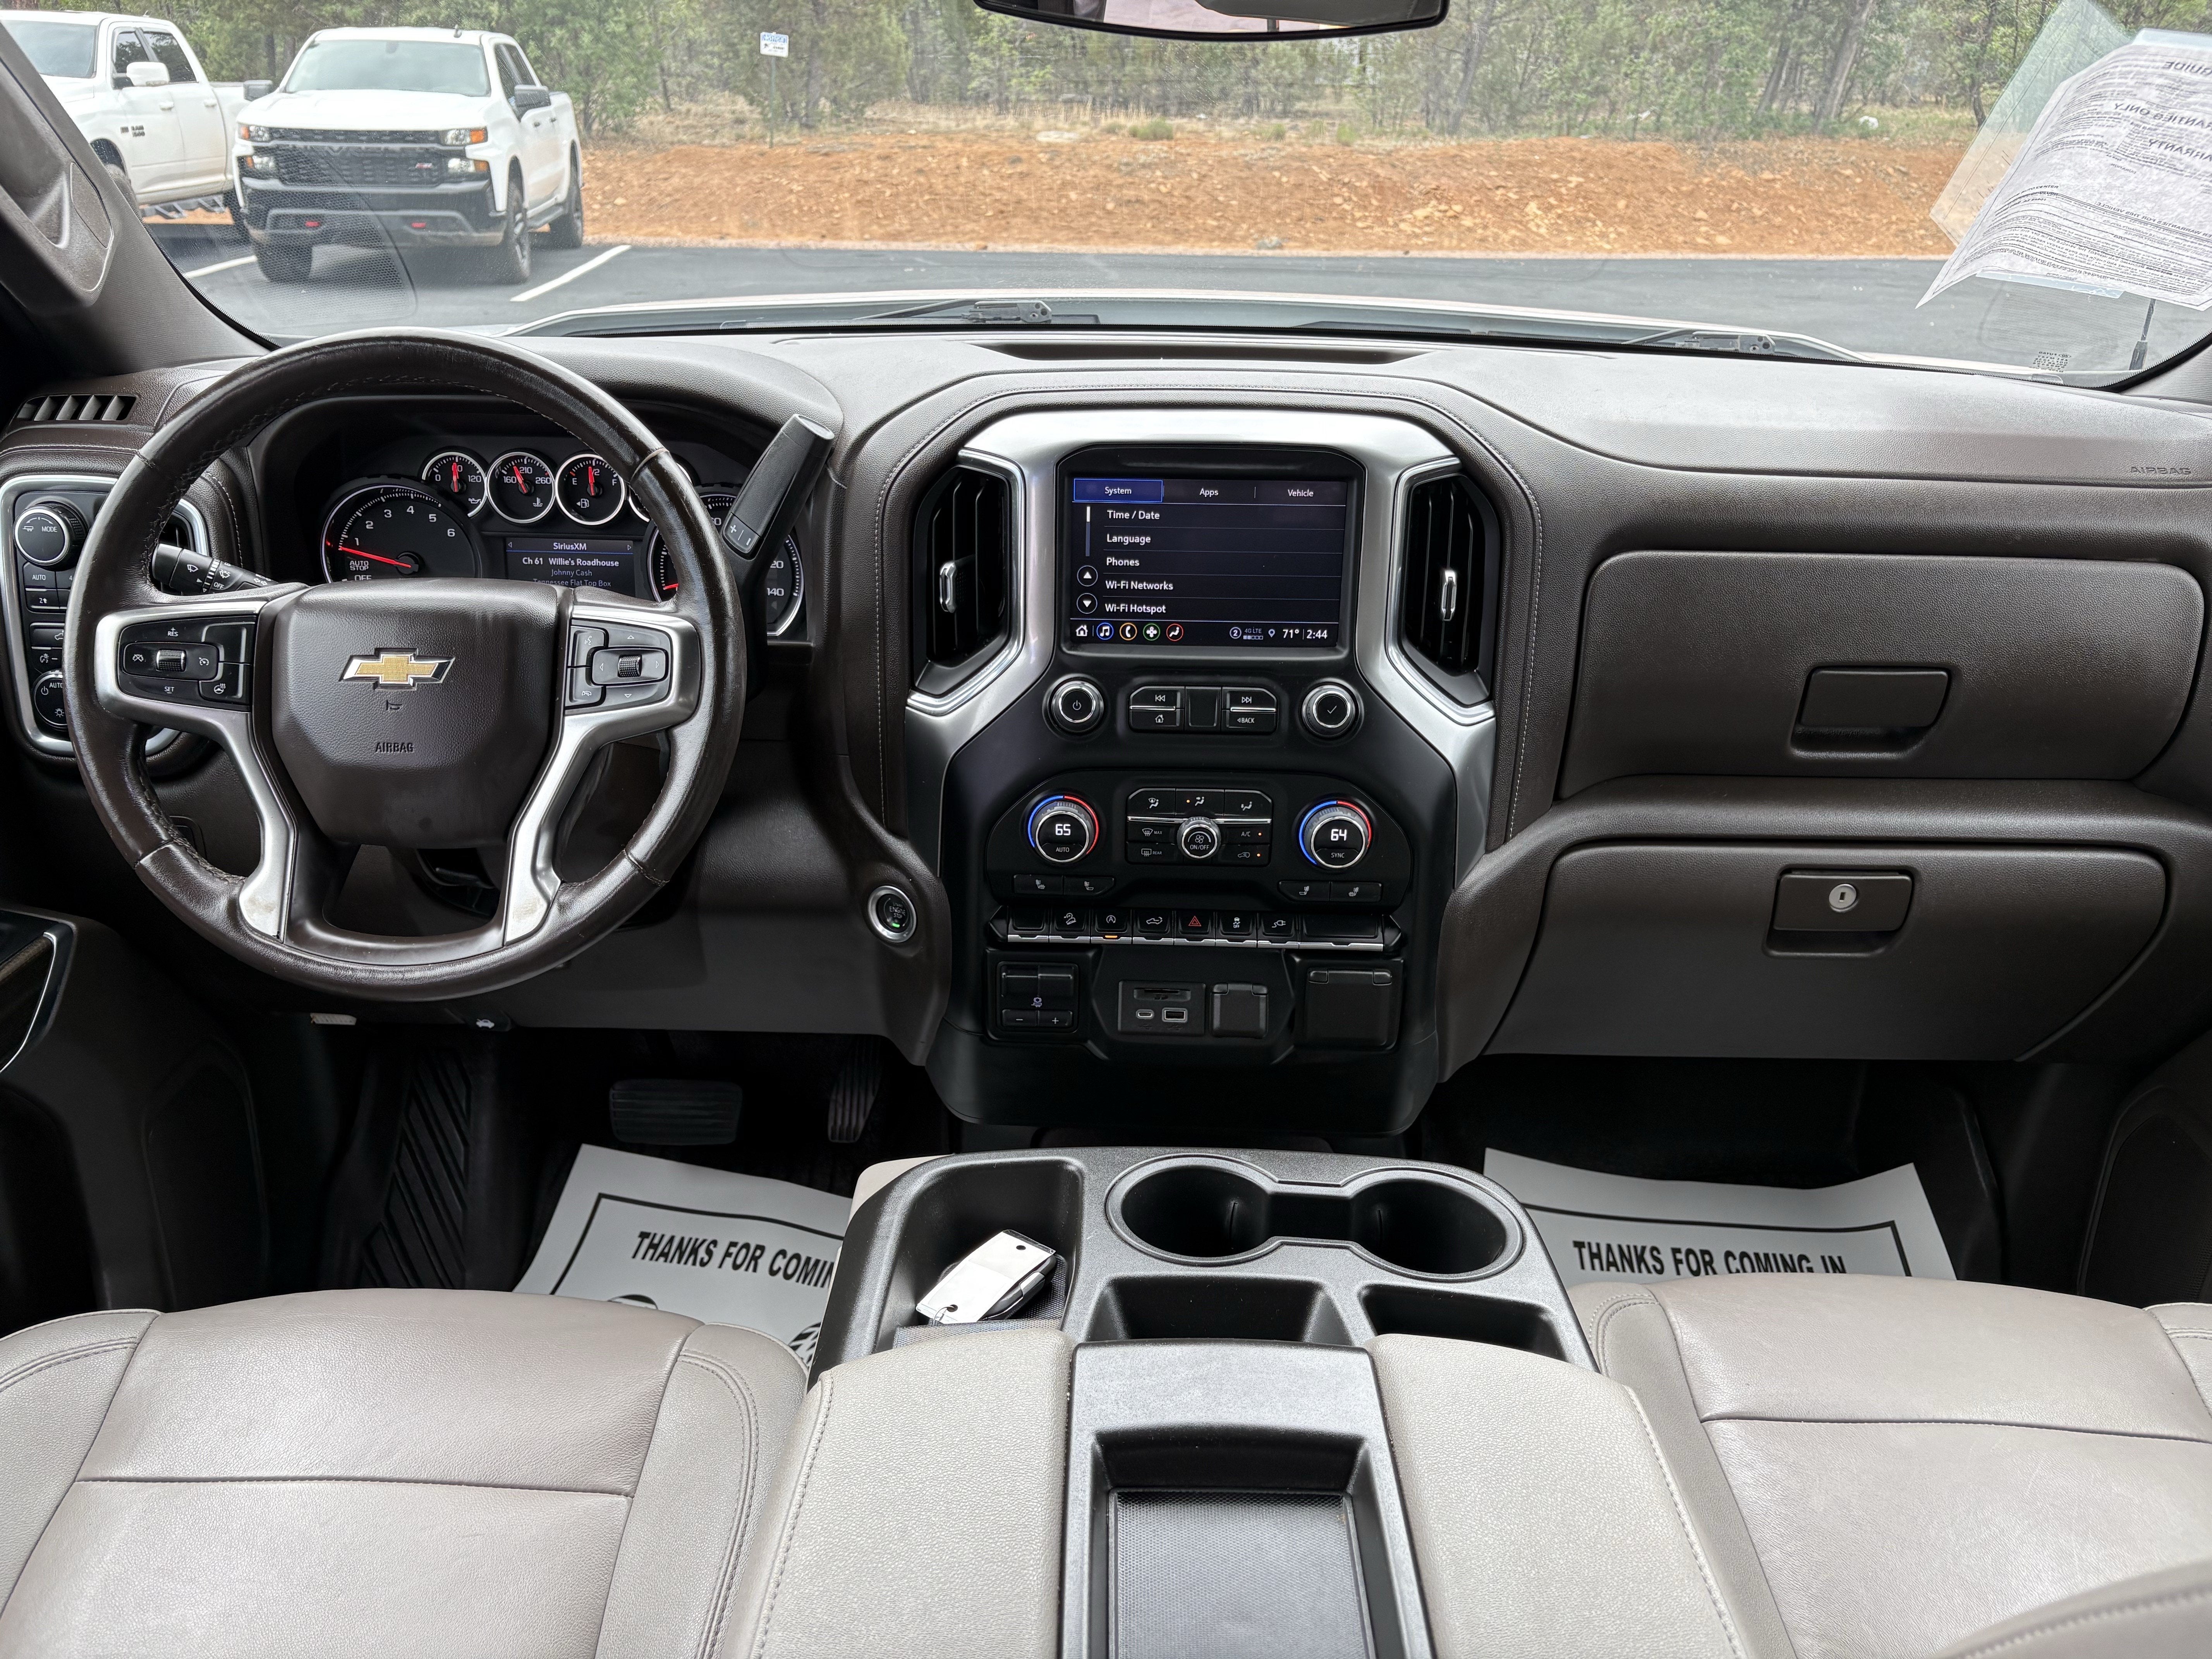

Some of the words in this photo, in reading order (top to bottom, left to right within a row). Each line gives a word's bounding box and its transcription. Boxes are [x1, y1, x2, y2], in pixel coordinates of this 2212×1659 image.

[2131, 467, 2191, 475] AIRBAG
[1105, 487, 1132, 496] System
[1199, 488, 1219, 497] Apps
[1288, 489, 1314, 497] Vehicle
[384, 510, 392, 518] 3
[407, 506, 414, 514] 4
[429, 514, 436, 522] 5
[1107, 510, 1130, 519] Time
[1132, 511, 1137, 520] /
[1139, 511, 1160, 520] Date
[366, 521, 374, 529] 2
[447, 528, 455, 537] 6
[355, 538, 359, 546] 1
[1107, 534, 1151, 545] Language
[553, 542, 587, 550] SiriusXM
[548, 558, 575, 566] Willie's
[577, 558, 619, 567] Roadhouse
[1106, 558, 1140, 567] Phones
[551, 569, 574, 577] Johnny
[1106, 581, 1129, 590] Wi-Fi
[1131, 582, 1174, 590] Networks
[767, 588, 784, 596] 140
[1105, 604, 1128, 613] Wi-Fi
[1130, 605, 1166, 615] Hotspot
[1283, 629, 1299, 639] 71°
[1306, 630, 1328, 639] 2:44
[375, 742, 414, 753] AIRBAG
[1055, 824, 1071, 836] 65
[1331, 829, 1347, 841] 64
[631, 1231, 718, 1267] THANKS
[718, 1241, 766, 1273] FOR
[1573, 1240, 1664, 1275] THANKS
[1670, 1247, 1718, 1277] FOR
[1724, 1250, 1815, 1274] COMING
[1820, 1255, 1847, 1274] IN
